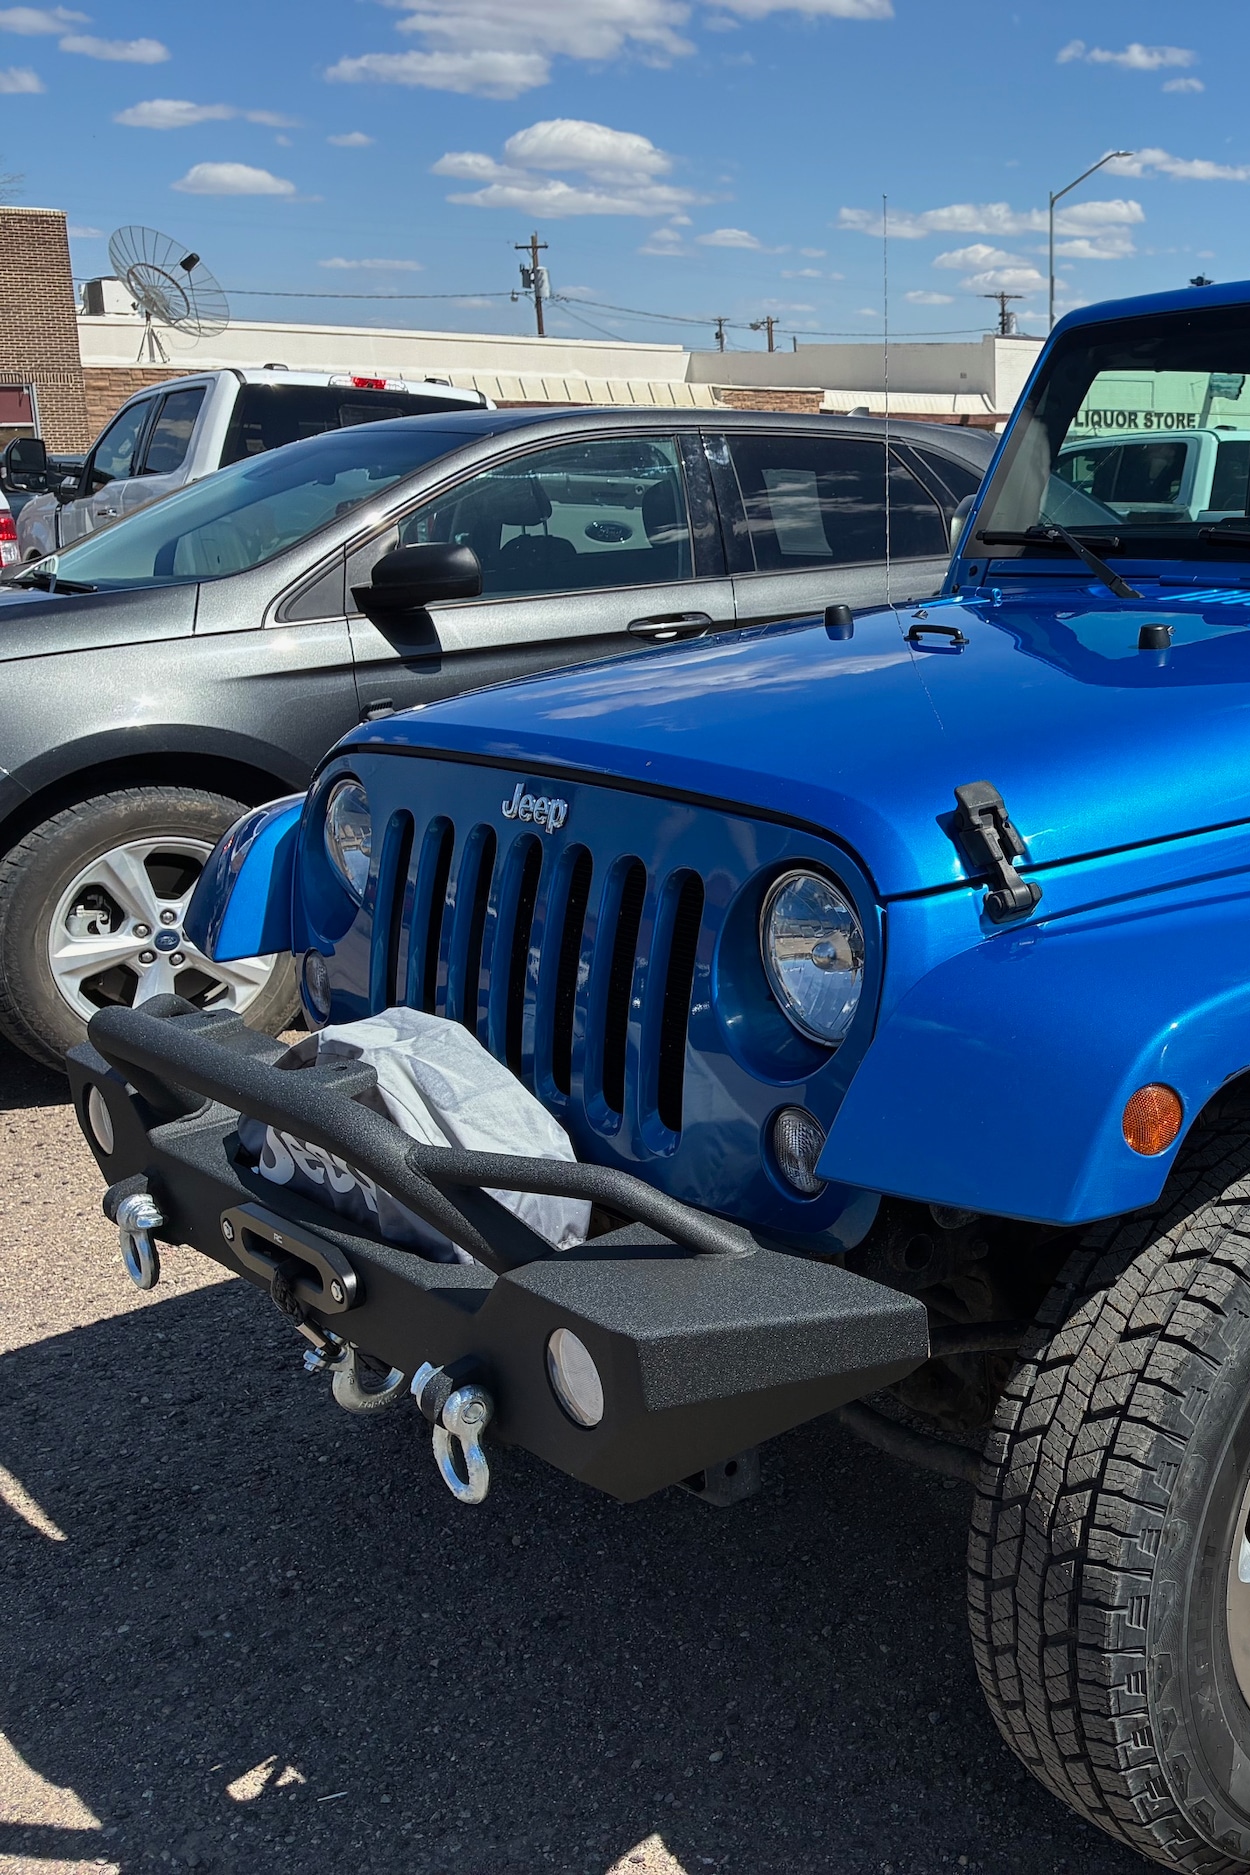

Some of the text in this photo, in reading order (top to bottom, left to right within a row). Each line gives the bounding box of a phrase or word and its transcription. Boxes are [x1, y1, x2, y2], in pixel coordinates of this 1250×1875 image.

[1074, 410, 1196, 430] LIQUOR STORE
[502, 783, 568, 834] Jeep
[273, 1232, 283, 1244] RC
